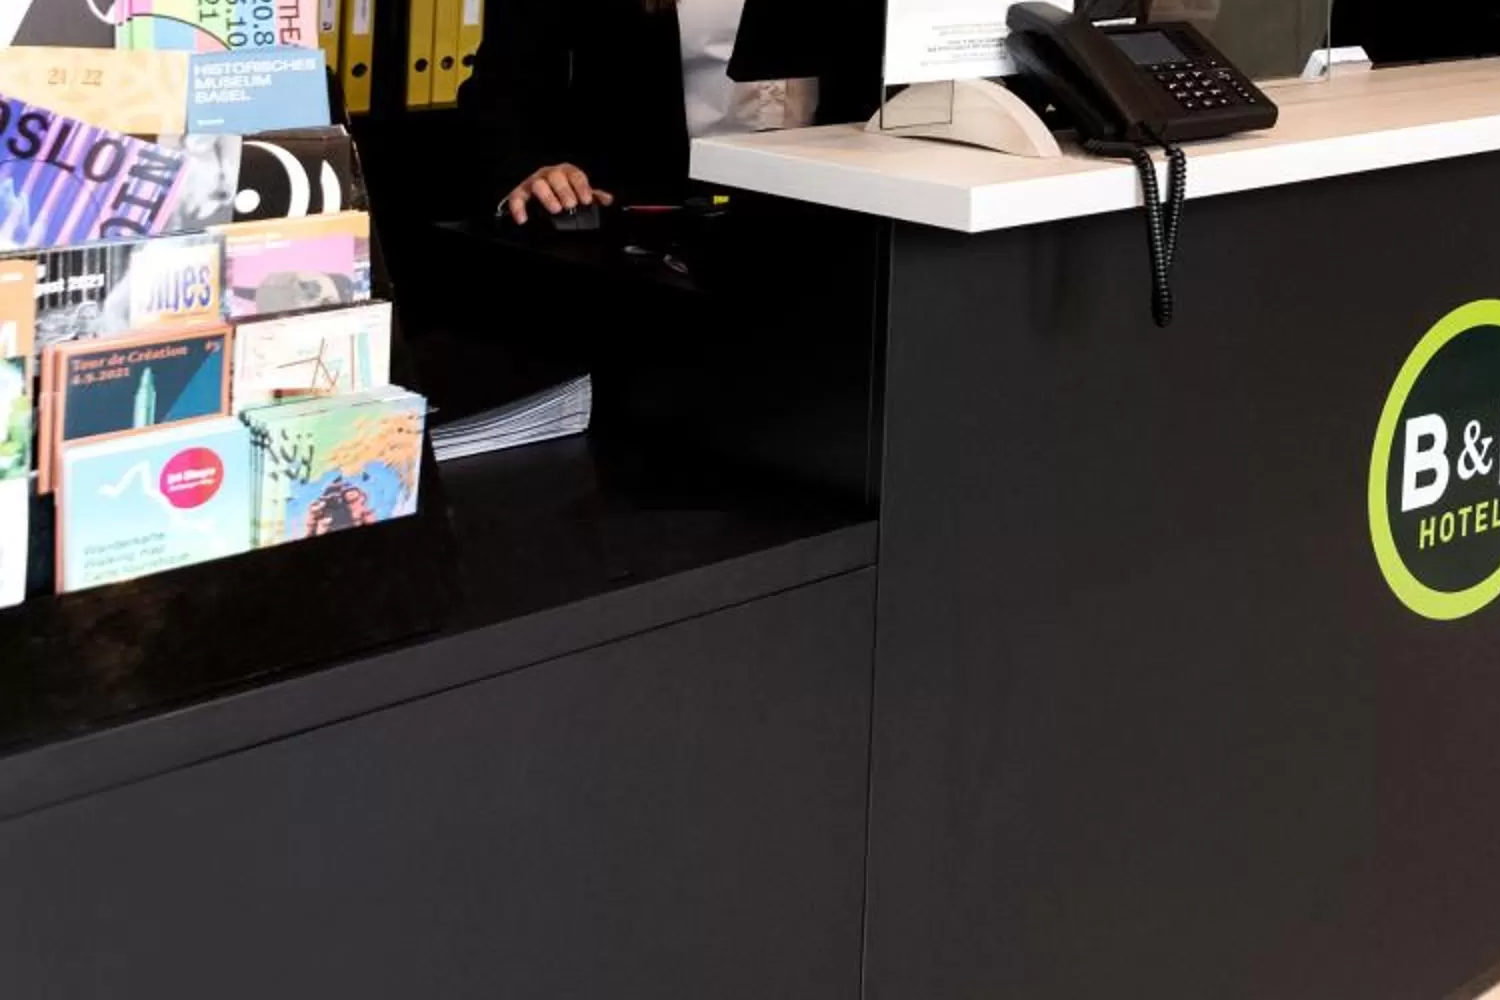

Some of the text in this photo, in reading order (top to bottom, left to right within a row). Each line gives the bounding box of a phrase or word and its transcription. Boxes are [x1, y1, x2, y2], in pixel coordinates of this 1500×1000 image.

[193, 58, 317, 76] HISTORISCHES
[194, 73, 273, 90] MUSEUM
[194, 88, 251, 104] BASEL
[0, 100, 126, 184] SLO
